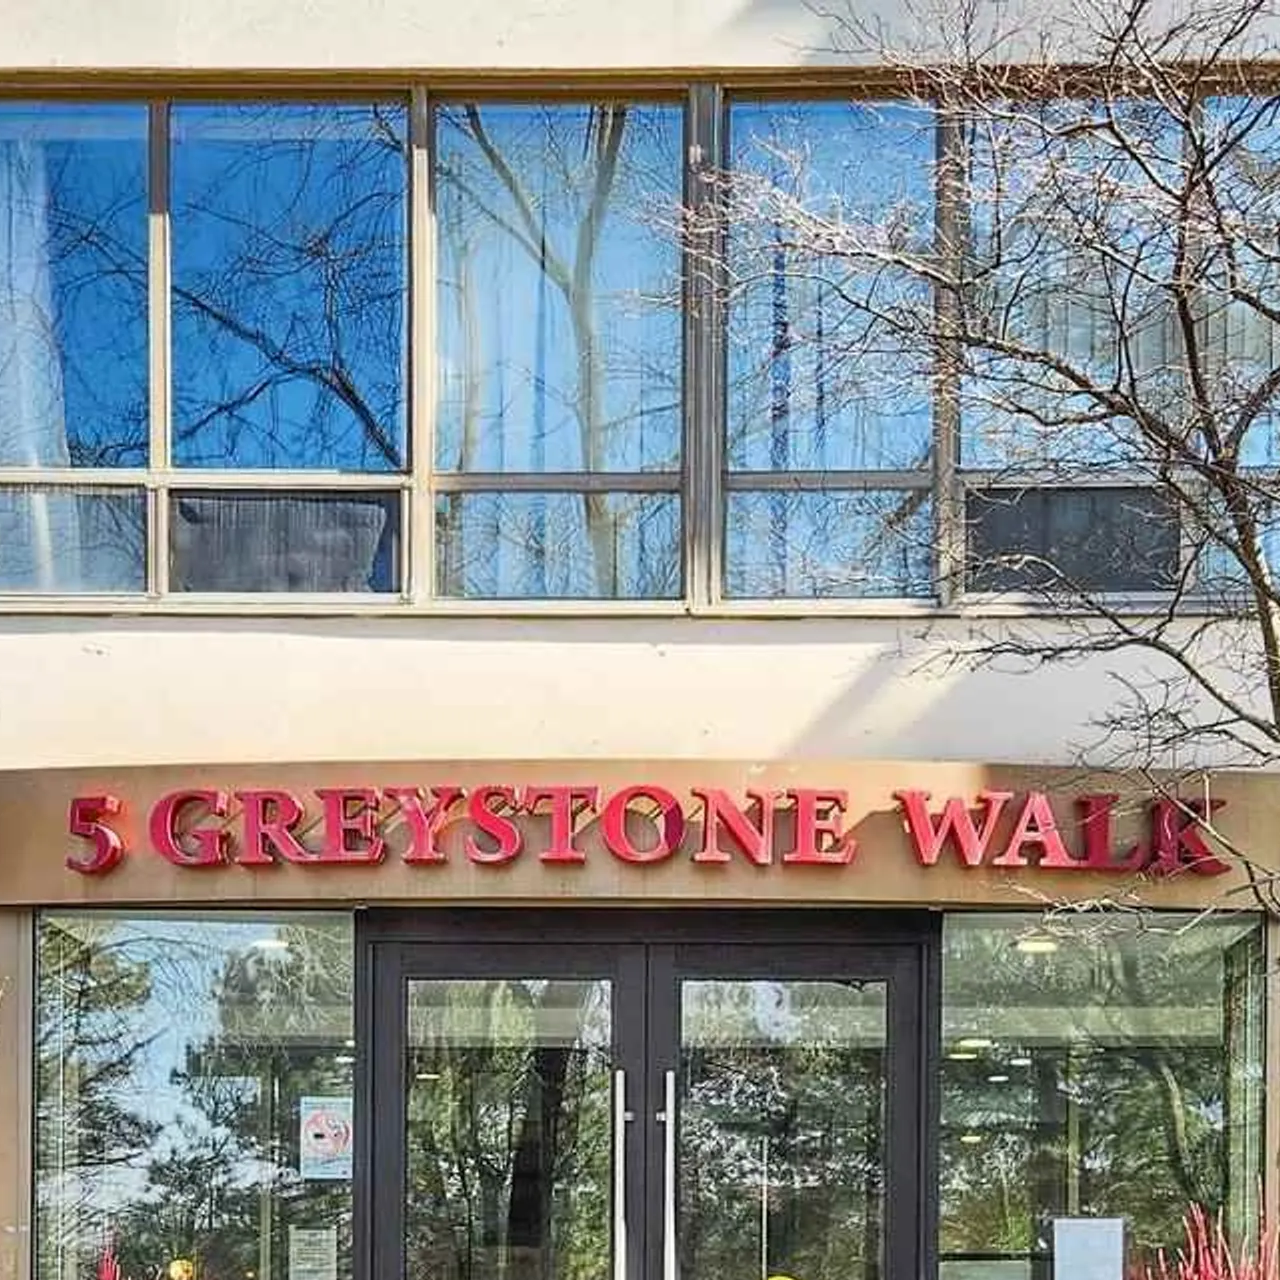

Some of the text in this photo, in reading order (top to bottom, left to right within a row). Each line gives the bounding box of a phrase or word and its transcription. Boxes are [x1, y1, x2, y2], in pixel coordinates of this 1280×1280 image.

[66, 783, 1233, 876] 5 GREYSTONE WALK
